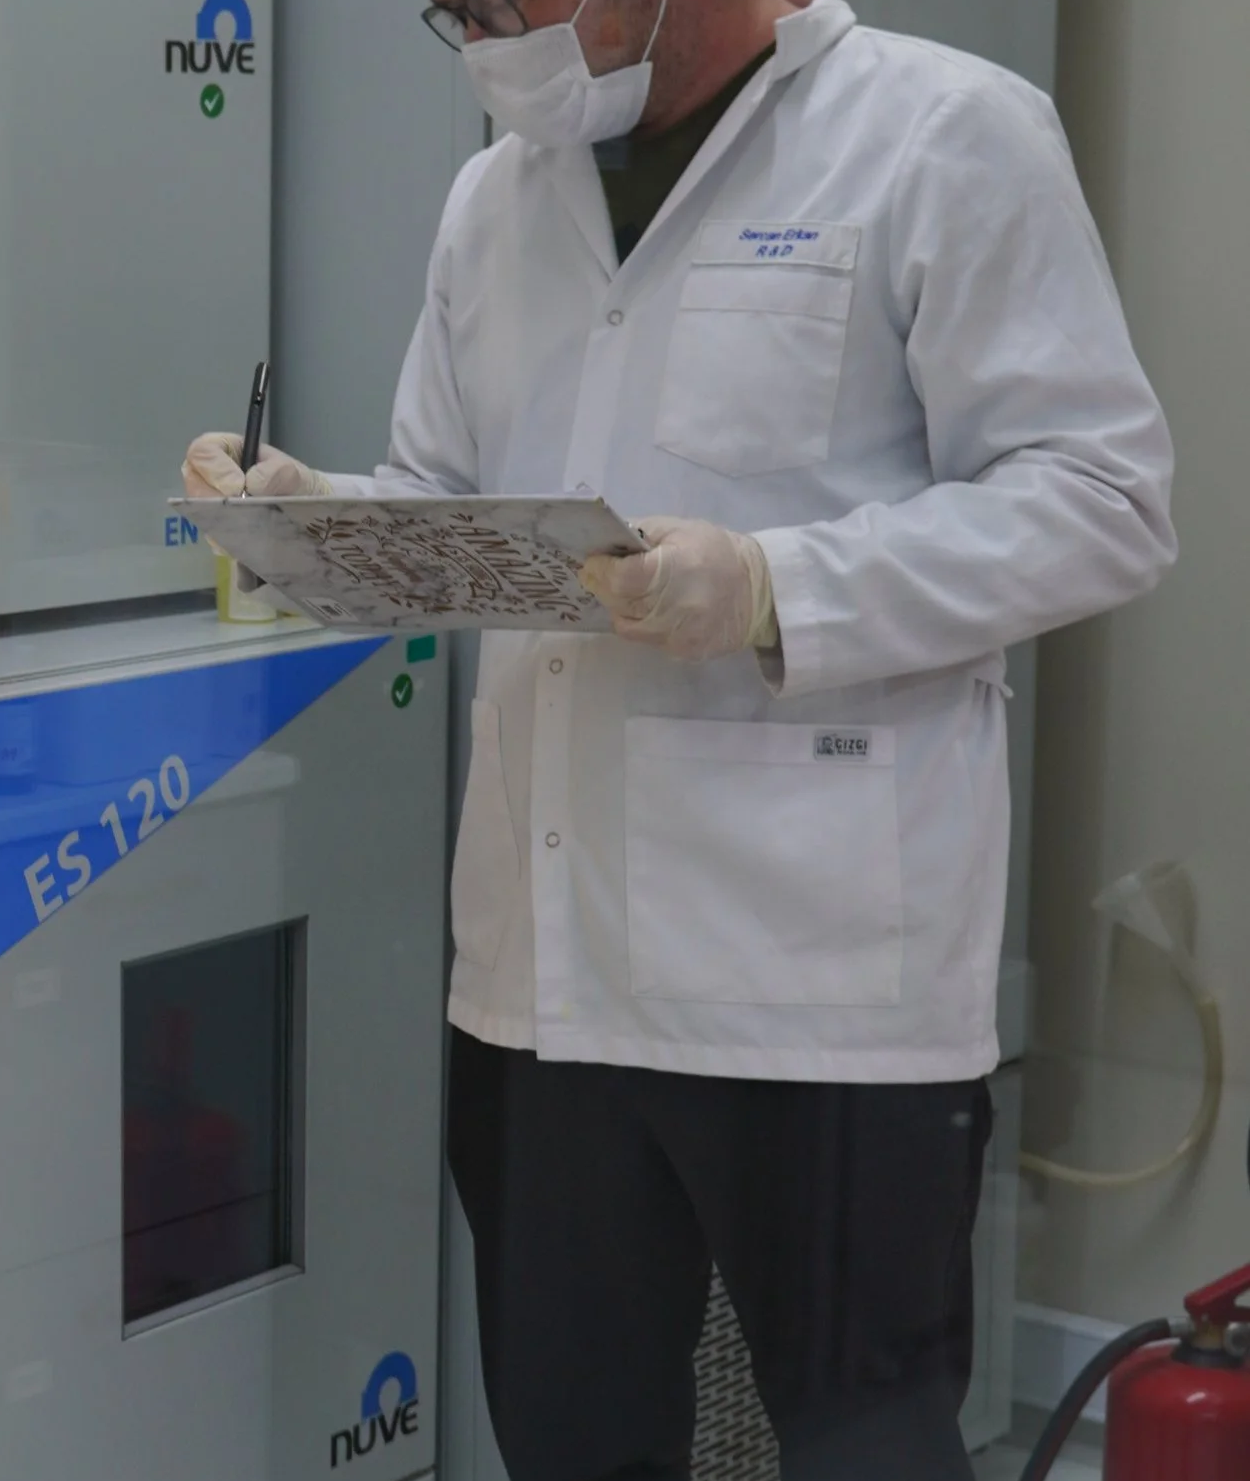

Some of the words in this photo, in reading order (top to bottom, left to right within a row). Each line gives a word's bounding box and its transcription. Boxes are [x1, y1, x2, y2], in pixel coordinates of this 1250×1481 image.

[164, 515, 199, 548] EN
[449, 522, 581, 613] AMAZING
[23, 830, 93, 923] ES
[100, 754, 191, 860] 120
